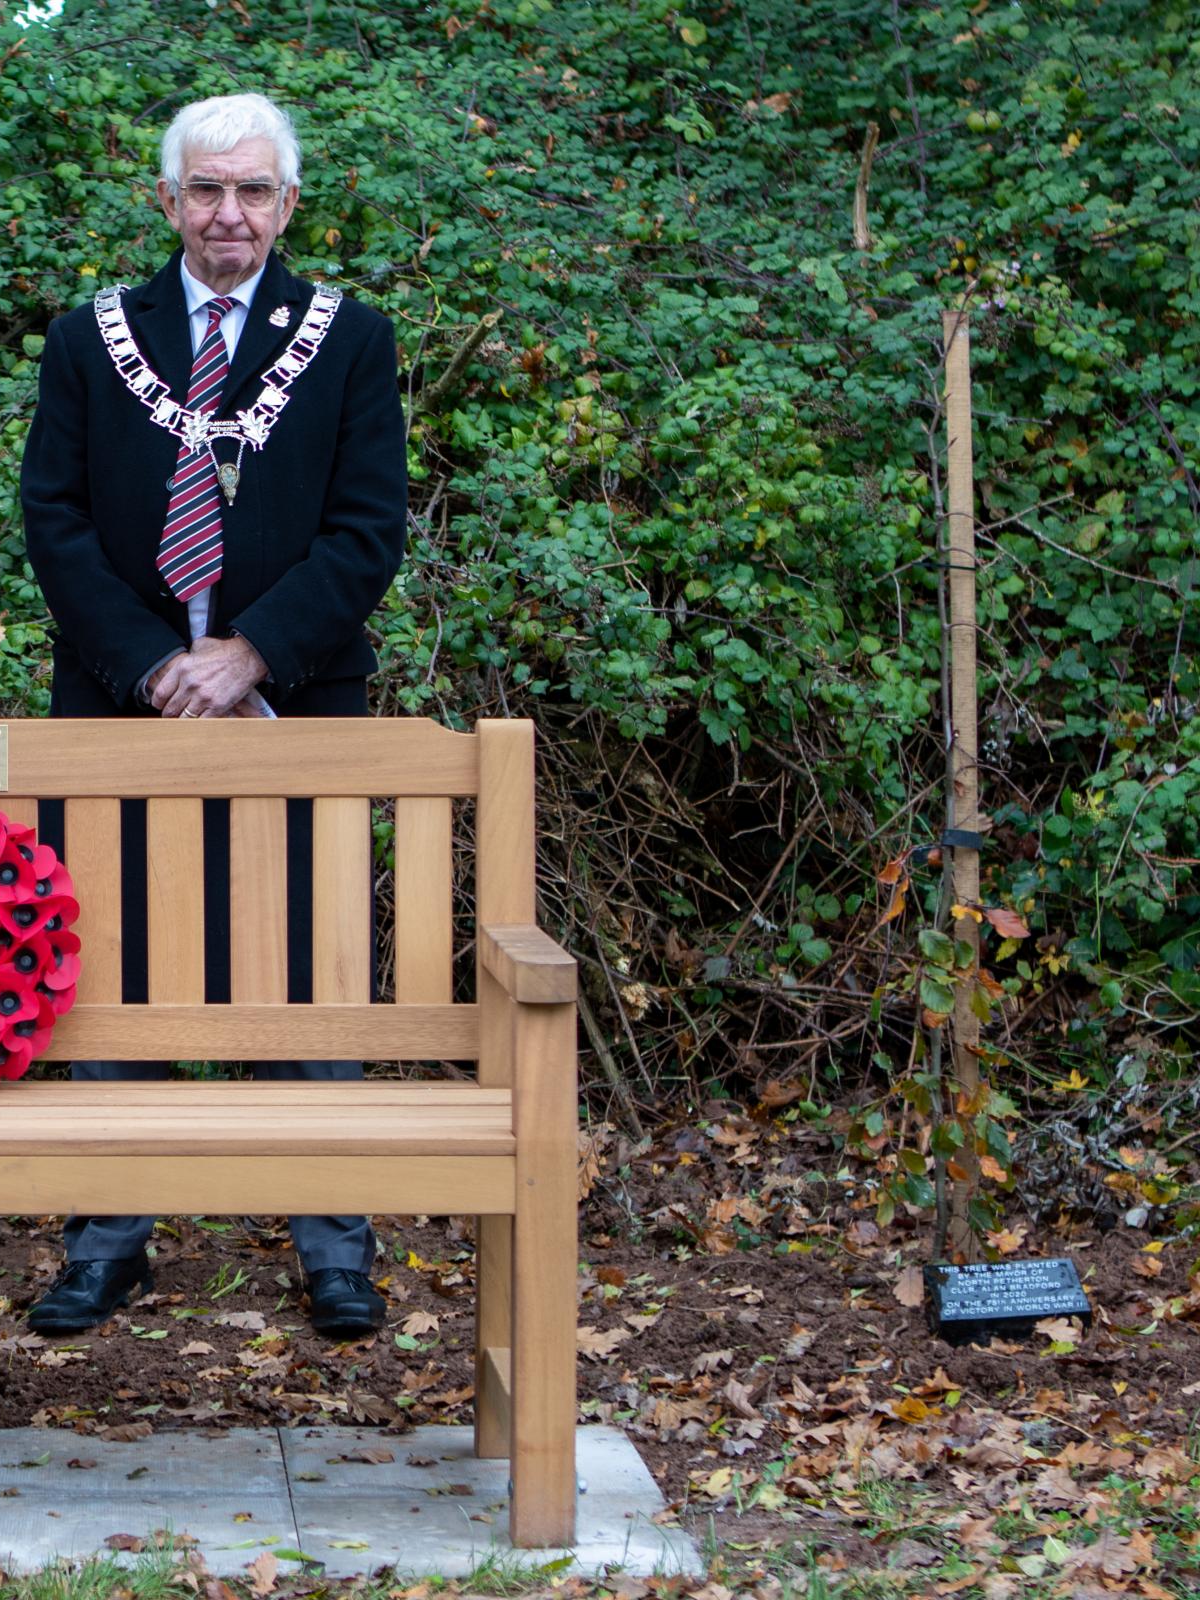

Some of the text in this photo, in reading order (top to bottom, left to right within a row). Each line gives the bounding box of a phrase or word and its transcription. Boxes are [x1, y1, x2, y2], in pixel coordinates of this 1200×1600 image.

[938, 1261, 1058, 1274] THIS TREE WAS PLANTED
[958, 1276, 1049, 1287] NORTH PETHERTON
[1010, 1282, 1061, 1290] BRADFORD
[1010, 1295, 1075, 1304] ANNIVERSARY
[960, 1307, 1000, 1315] VICTORY
[1053, 1301, 1074, 1309] WAR
